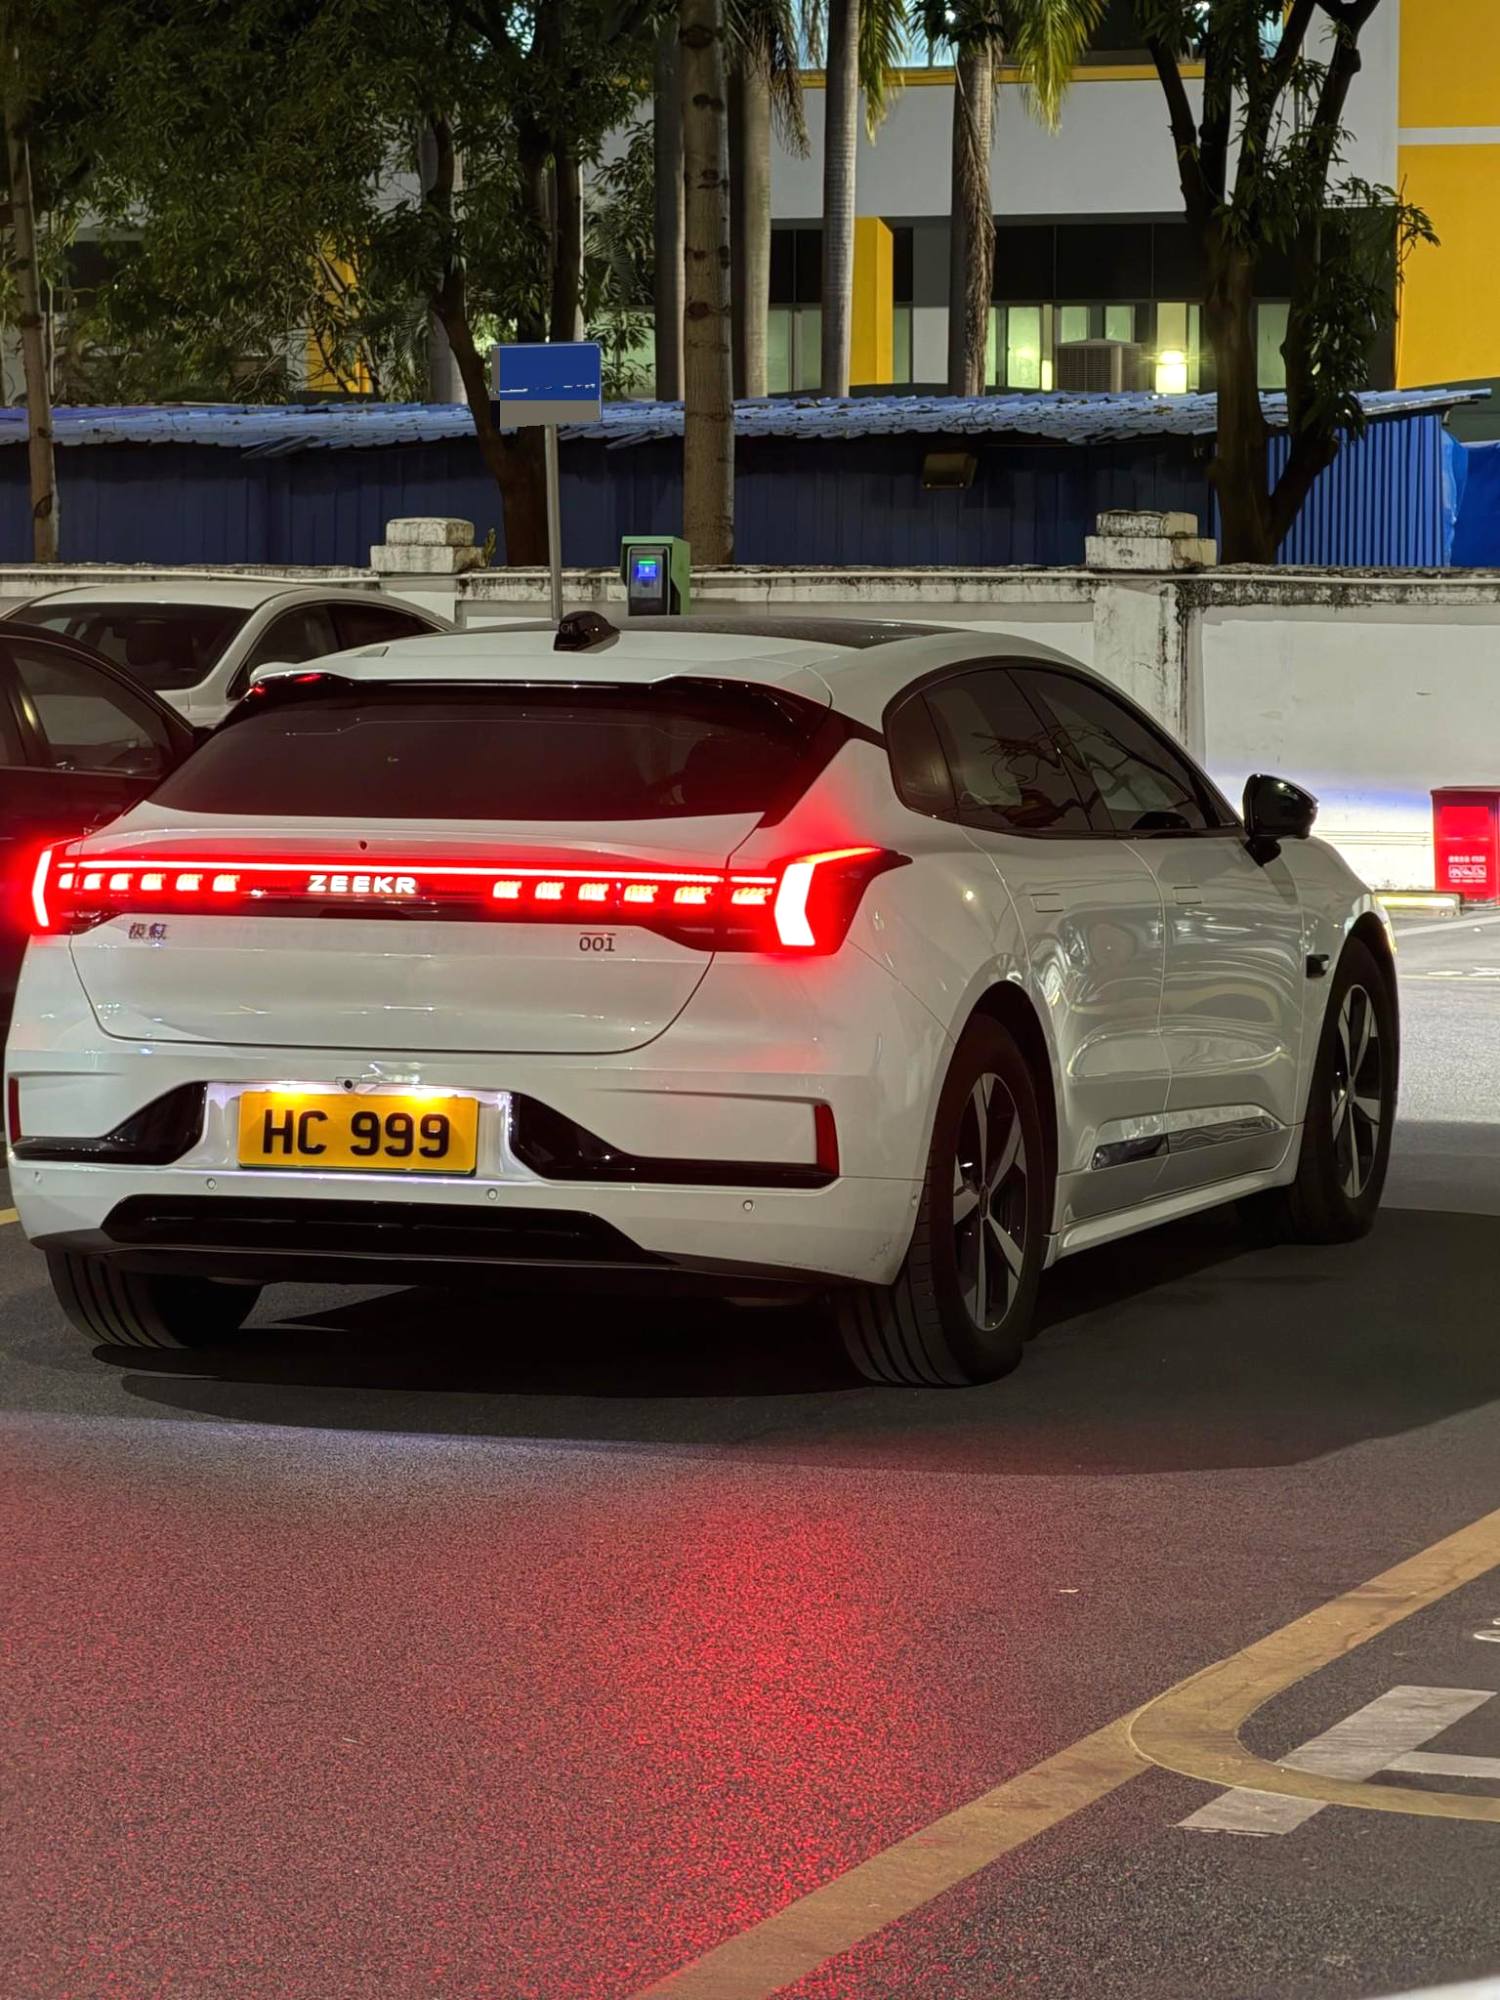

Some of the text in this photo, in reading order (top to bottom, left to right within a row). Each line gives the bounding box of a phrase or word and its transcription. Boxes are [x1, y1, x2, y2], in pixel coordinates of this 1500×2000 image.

[307, 874, 416, 894] ZEEKR
[579, 936, 616, 952] 001
[262, 1109, 450, 1159] HC 999
